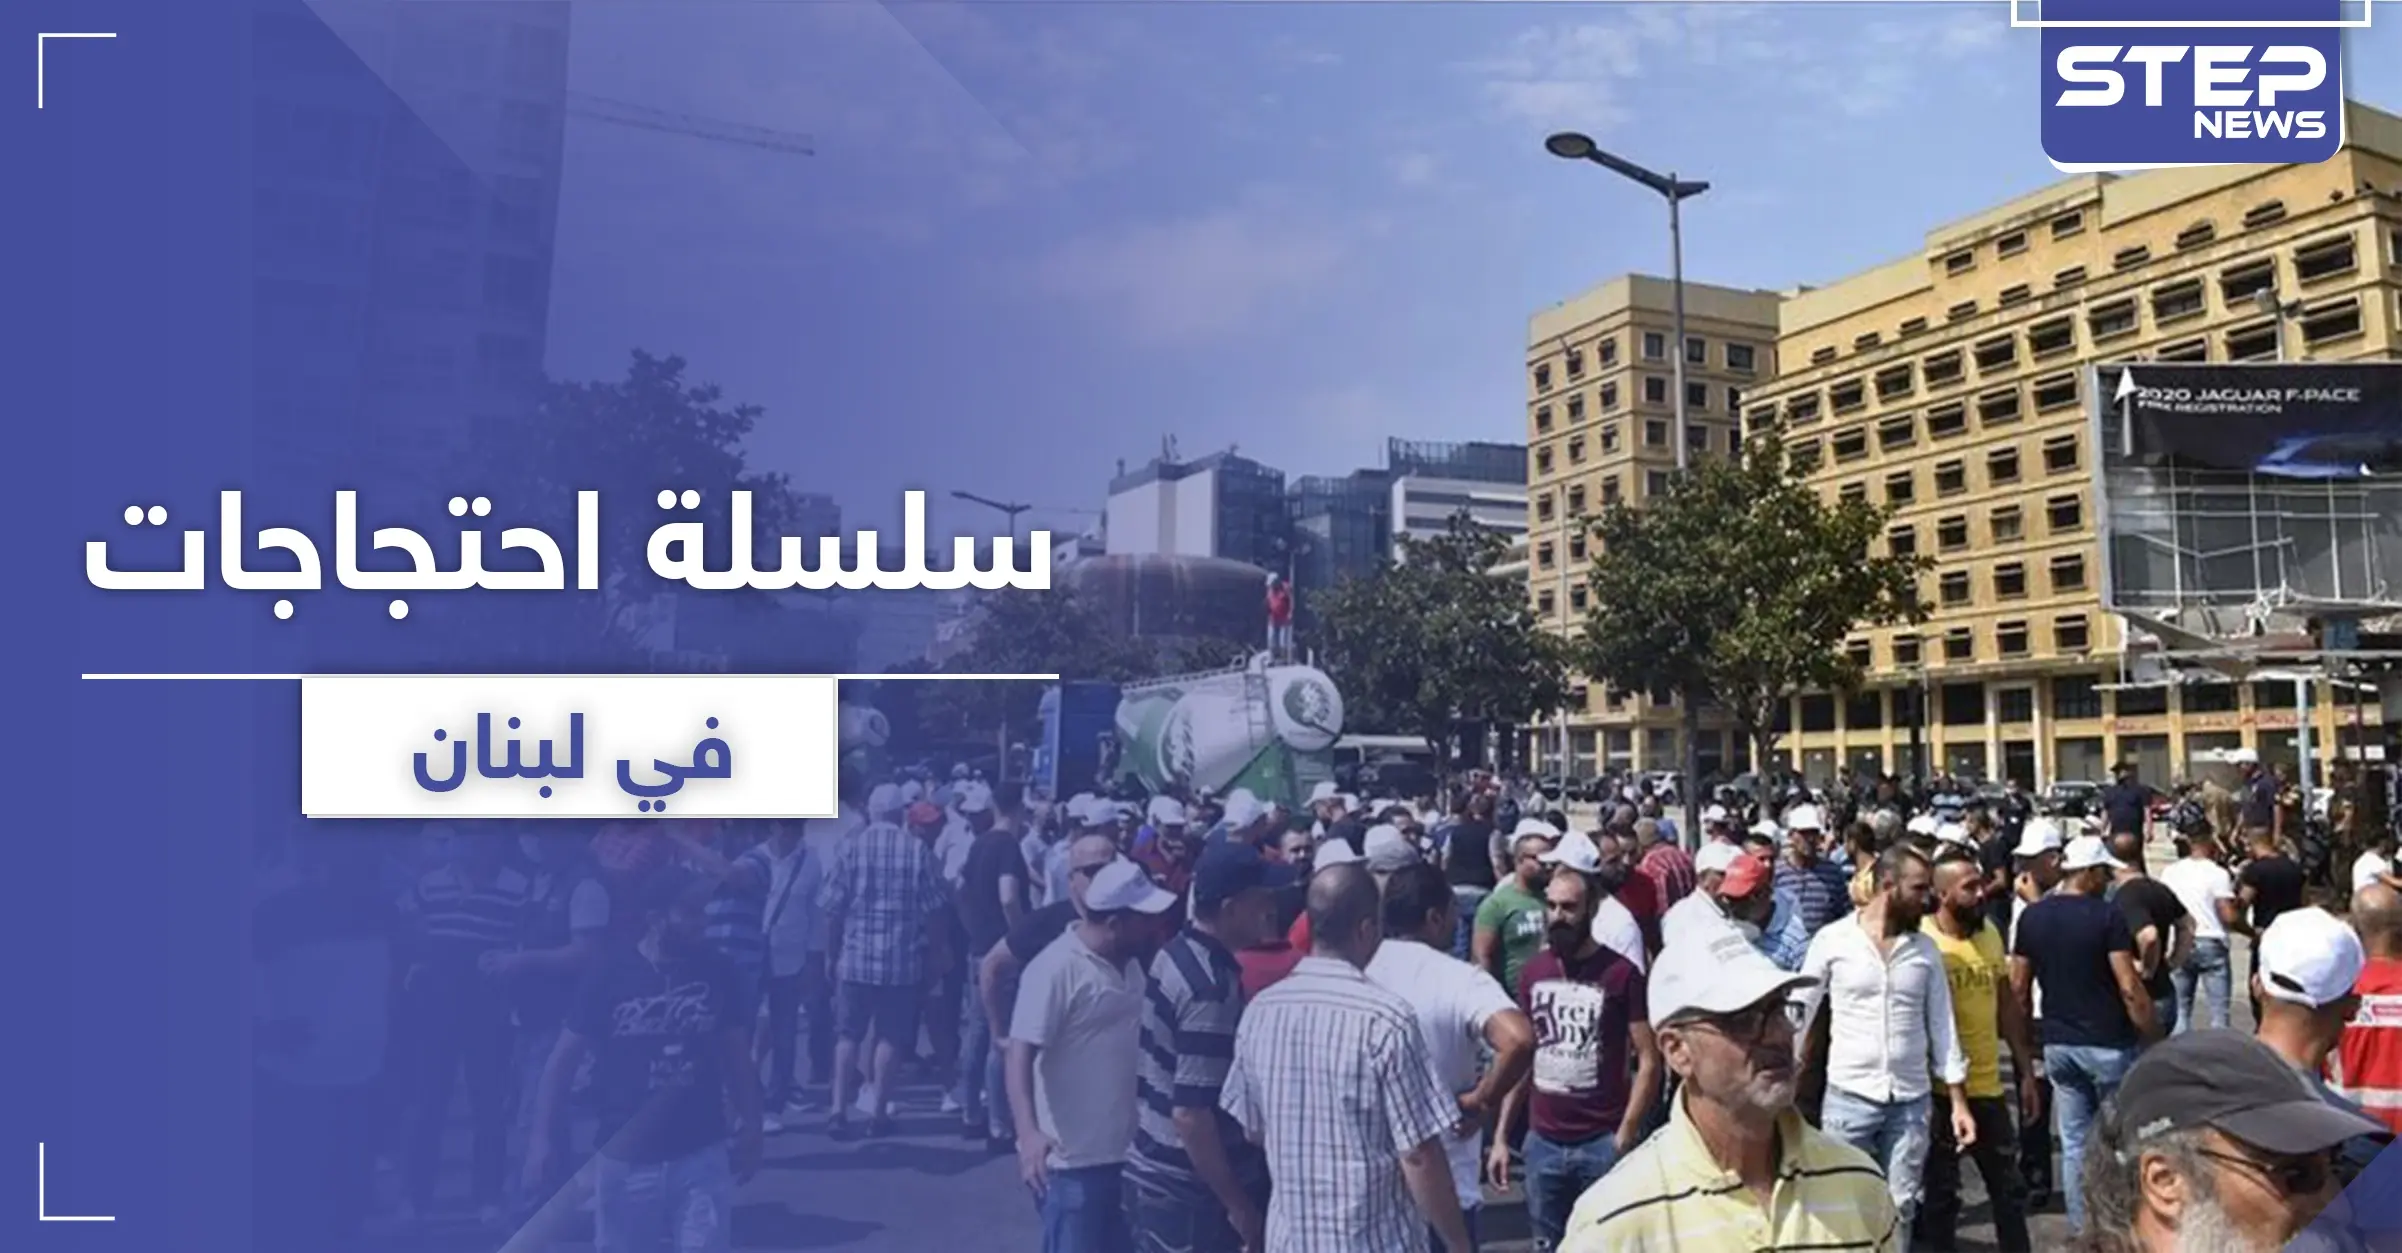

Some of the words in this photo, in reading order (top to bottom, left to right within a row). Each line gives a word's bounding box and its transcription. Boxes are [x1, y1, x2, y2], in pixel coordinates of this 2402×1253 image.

[2135, 386, 2192, 401] 2020
[2195, 388, 2281, 402] JAGUAR
[2285, 387, 2361, 403] F-PACE
[2174, 402, 2283, 414] REGISTRATION
